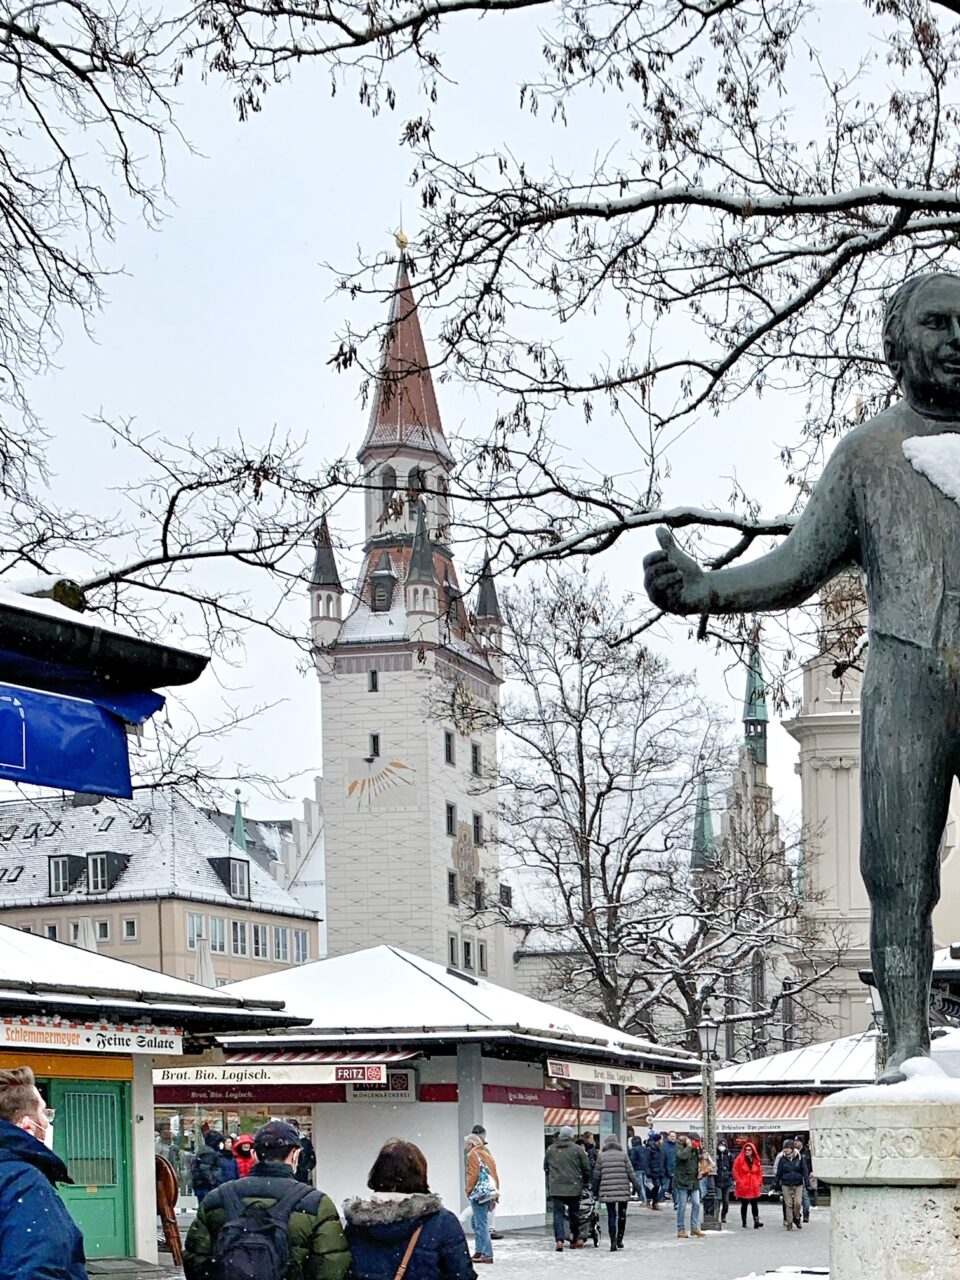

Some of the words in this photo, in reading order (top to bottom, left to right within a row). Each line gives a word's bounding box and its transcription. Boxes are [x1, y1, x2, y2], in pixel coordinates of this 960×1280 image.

[5, 1026, 81, 1047] Schlemmermeyer
[95, 1032, 132, 1049] Feine
[135, 1034, 175, 1050] Salate
[161, 1069, 191, 1081] Brot.
[194, 1069, 218, 1080] Bio.
[221, 1068, 271, 1082] Logisch.
[337, 1069, 364, 1079] FRITZ
